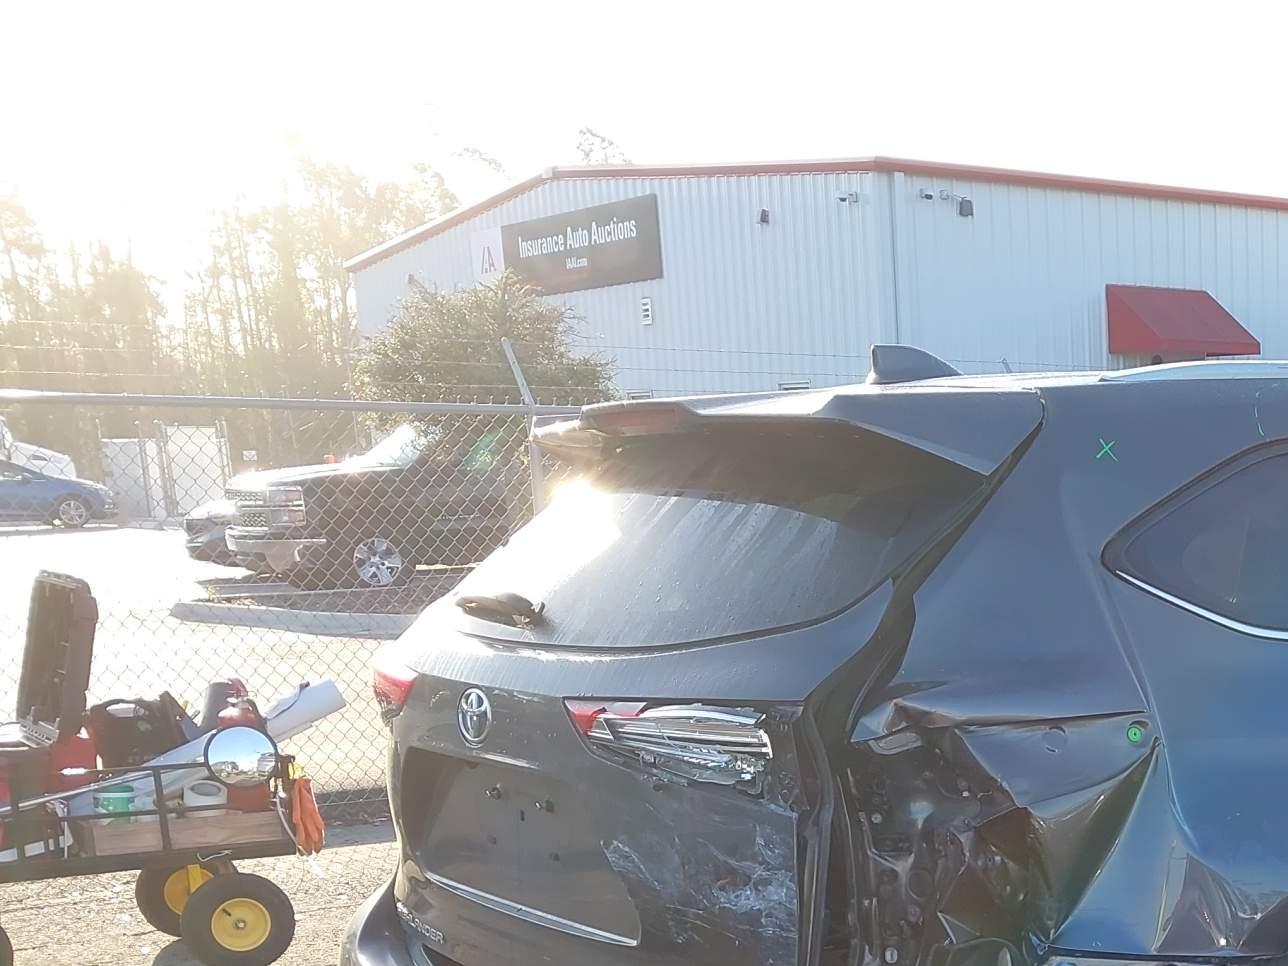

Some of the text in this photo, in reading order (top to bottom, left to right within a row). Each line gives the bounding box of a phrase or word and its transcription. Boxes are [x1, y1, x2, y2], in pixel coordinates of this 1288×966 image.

[518, 217, 637, 258] Insurance Auto Auctions
